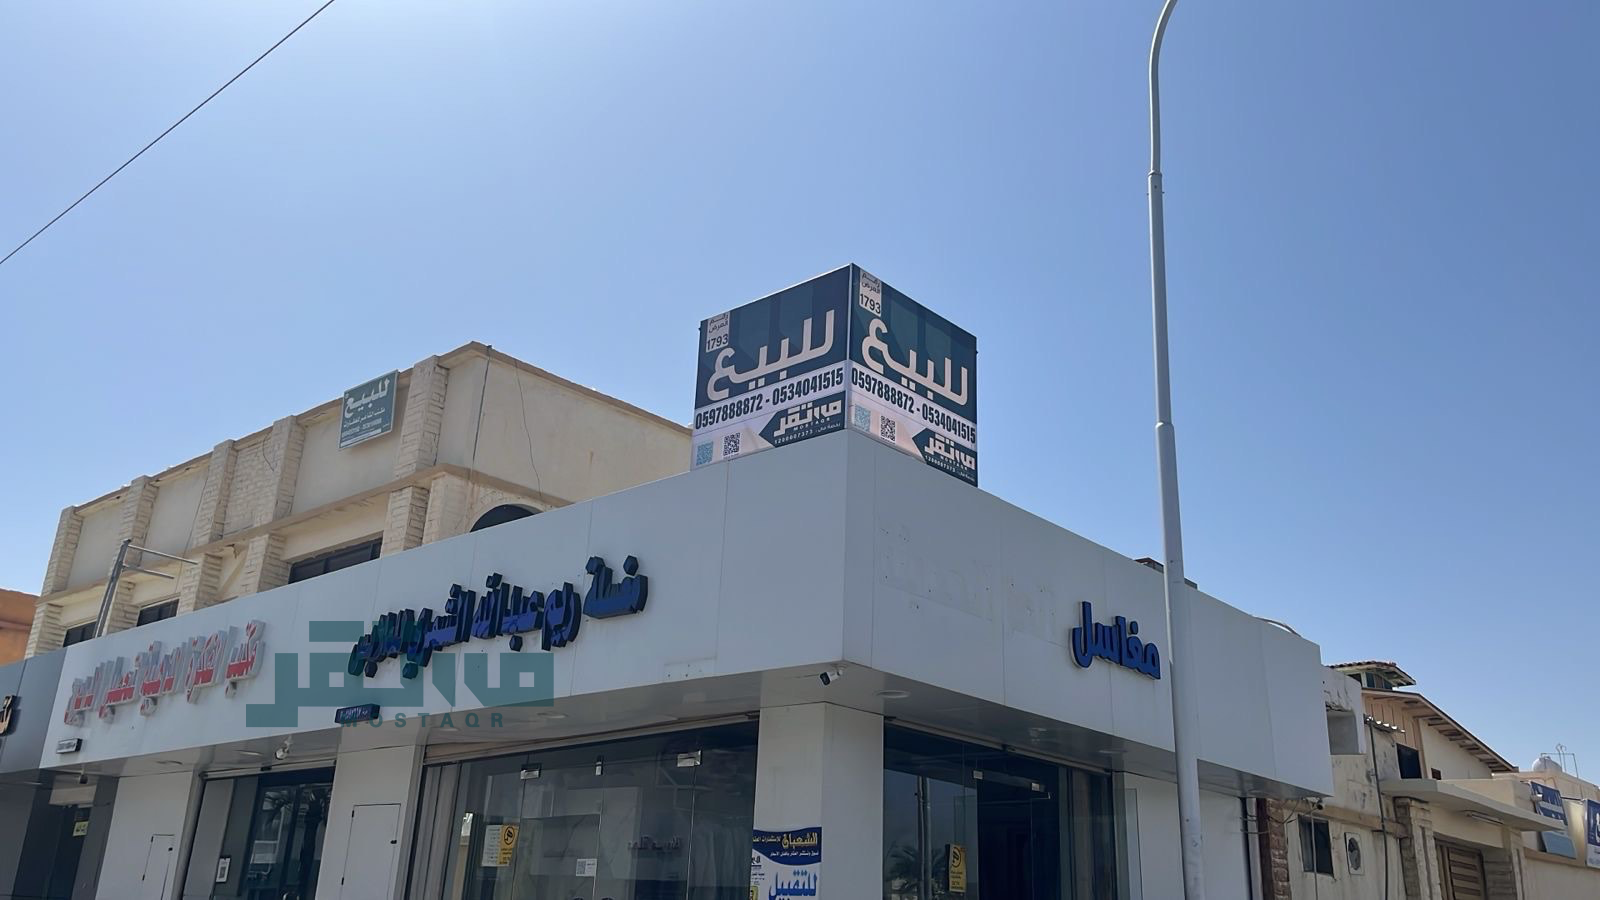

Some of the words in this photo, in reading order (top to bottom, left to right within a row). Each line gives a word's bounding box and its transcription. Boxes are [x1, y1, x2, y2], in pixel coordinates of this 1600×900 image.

[860, 293, 881, 315] 1793
[707, 333, 729, 351] 1793
[707, 309, 835, 401] للبيع
[861, 318, 968, 406] للبيع
[344, 378, 390, 419] للبيع
[695, 393, 763, 430] 0597888872
[772, 367, 844, 406] 0534041515
[851, 367, 915, 415] 0597888872
[921, 403, 976, 445] 0534041515
[1072, 600, 1161, 680] مغاسل
